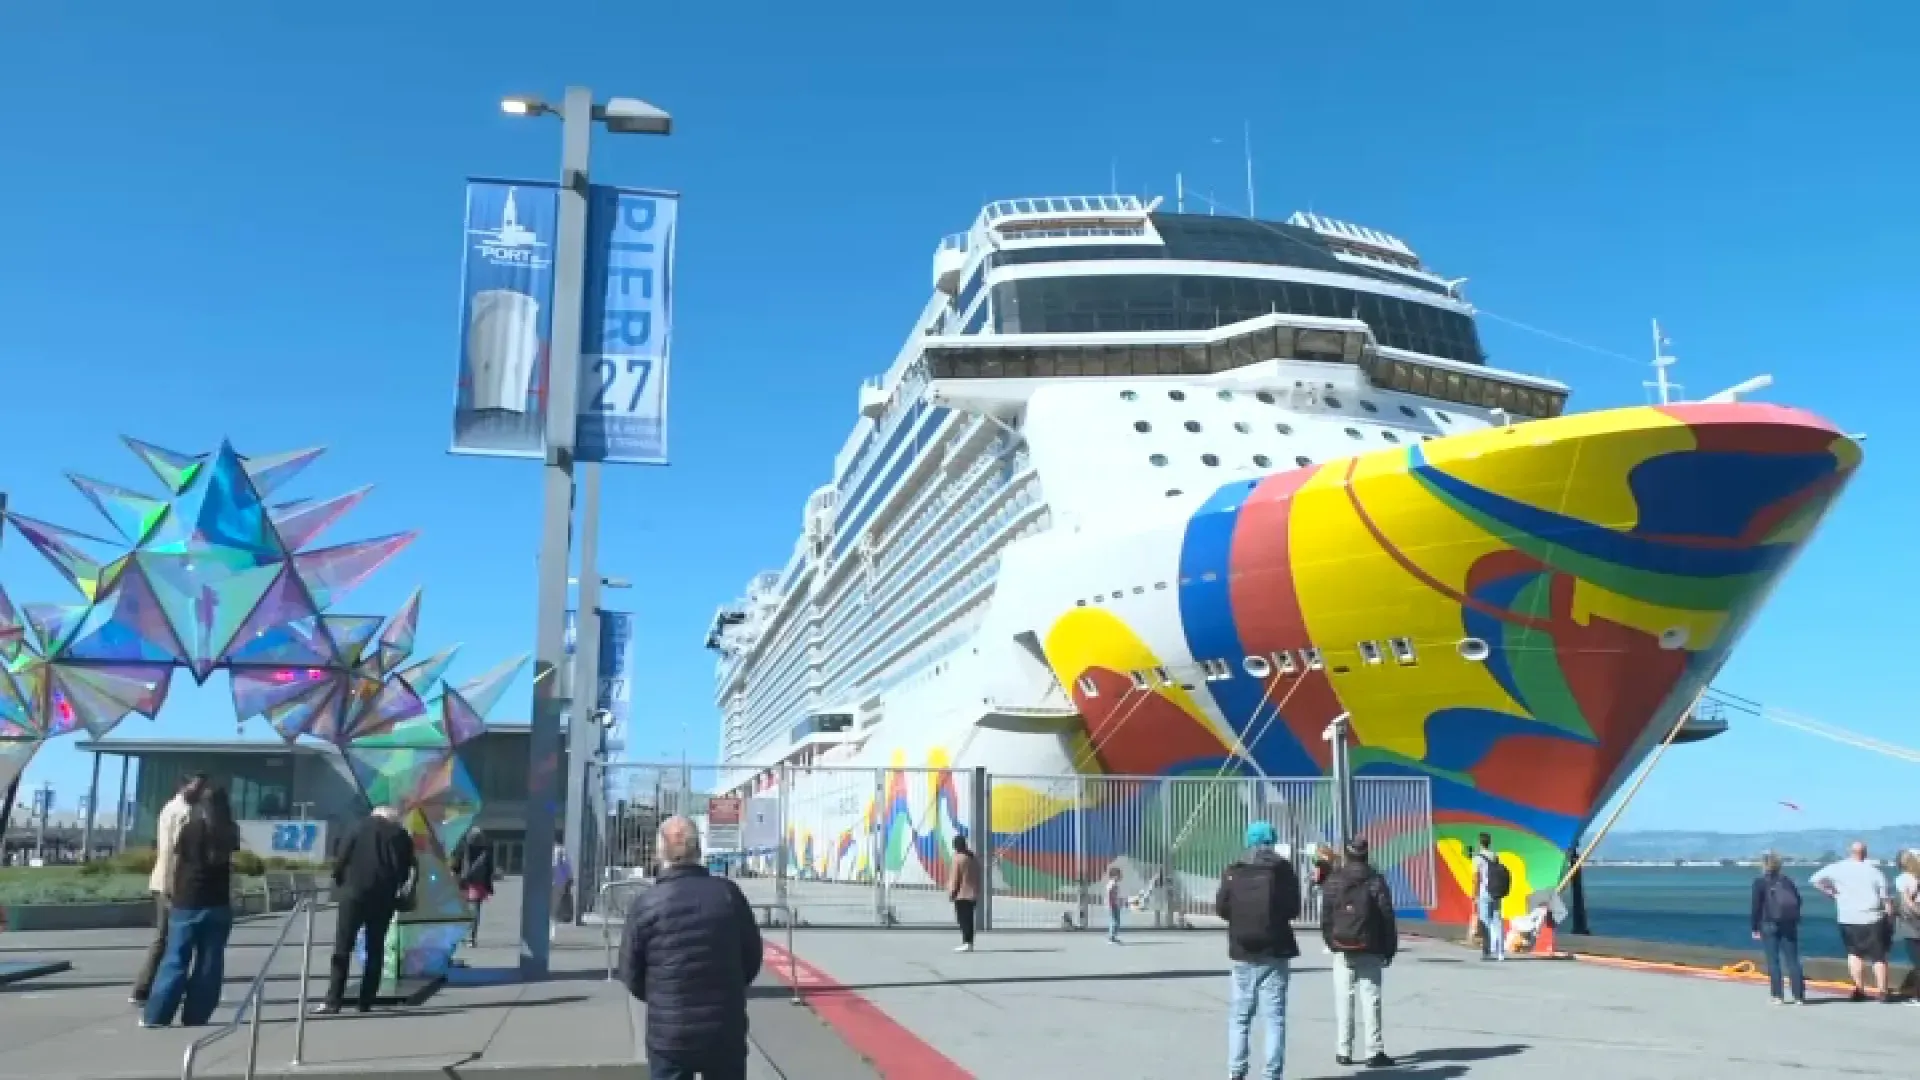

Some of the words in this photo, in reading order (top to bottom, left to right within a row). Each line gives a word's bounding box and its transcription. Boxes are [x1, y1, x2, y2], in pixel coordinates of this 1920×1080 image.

[482, 247, 531, 264] PORT
[603, 198, 657, 347] PIER
[589, 358, 652, 412] 27
